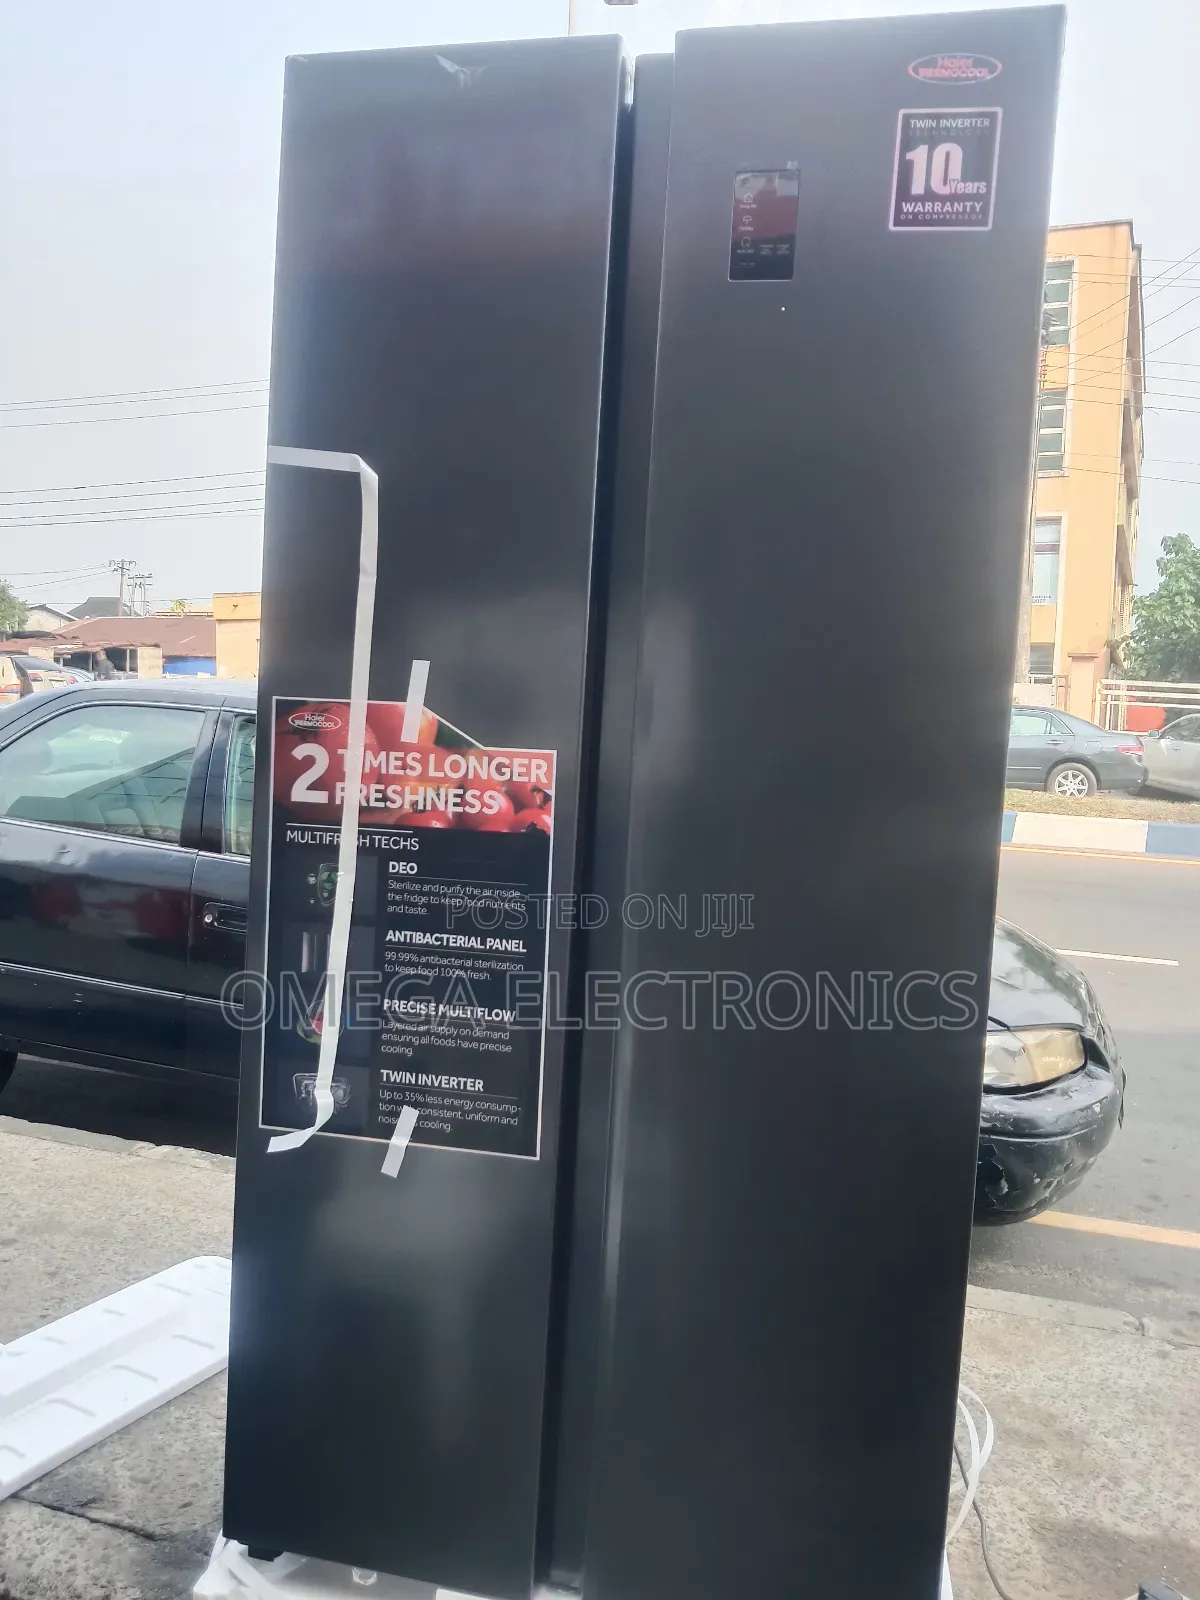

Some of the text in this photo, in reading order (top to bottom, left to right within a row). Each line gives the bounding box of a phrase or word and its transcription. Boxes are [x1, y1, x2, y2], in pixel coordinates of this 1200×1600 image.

[909, 118, 991, 129] TWIN INVERTER
[905, 142, 987, 195] 10 Years
[901, 202, 983, 213] WARRANTY
[294, 719, 336, 729] THERMOCOOL
[304, 713, 326, 722] Haier
[290, 742, 330, 804] 2
[337, 748, 549, 784] TMES LONGER
[286, 829, 419, 851] MULTIFRH TECHS
[388, 860, 418, 875] DEO
[387, 879, 521, 898] Sterilize and purify the air inside
[387, 892, 526, 912] the fridge to keep food nutrients
[387, 903, 430, 916] and taste.
[385, 930, 527, 953] ANTIBACTERIAL PANEL
[385, 951, 524, 972] 99.99% antibacterial sterilization
[384, 964, 492, 981] to keep food 100% fresh.
[383, 998, 517, 1023] PRECISE MULTIFLOW
[382, 1019, 510, 1041] Layered air supply on demand
[381, 1032, 512, 1053] ensuring all foods have precise
[381, 1044, 415, 1056] cooling.
[380, 1069, 484, 1092] TWIN INVERTER
[379, 1089, 522, 1115] Up to 35% less energy consump-
[379, 1102, 396, 1112] tion
[465, 1110, 500, 1124] uniform
[501, 1114, 518, 1126] and
[419, 1119, 453, 1133] cooling.
